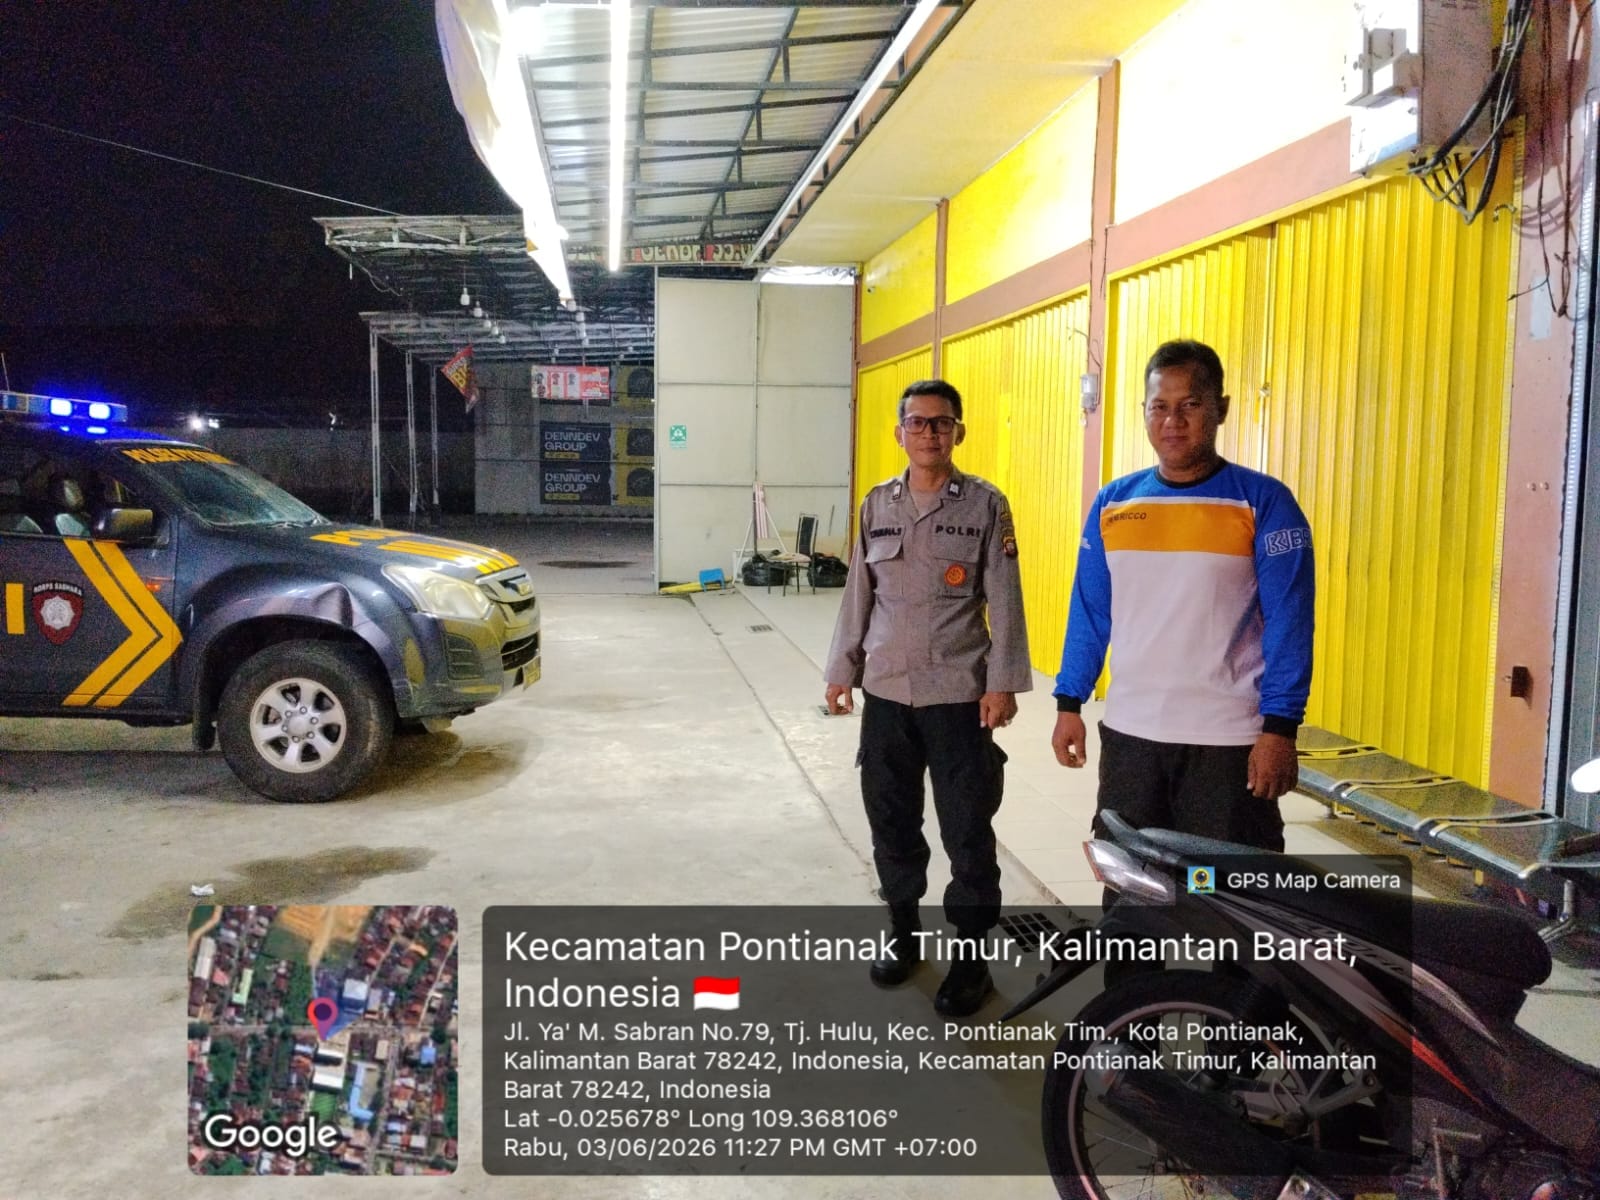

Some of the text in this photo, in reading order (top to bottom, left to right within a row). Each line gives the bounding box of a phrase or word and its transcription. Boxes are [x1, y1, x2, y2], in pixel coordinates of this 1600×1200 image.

[545, 431, 601, 442] DENNDEV
[545, 441, 587, 452] GROUP
[545, 472, 601, 483] DENNDEV
[545, 483, 587, 493] GROUP
[935, 524, 981, 538] POLRI
